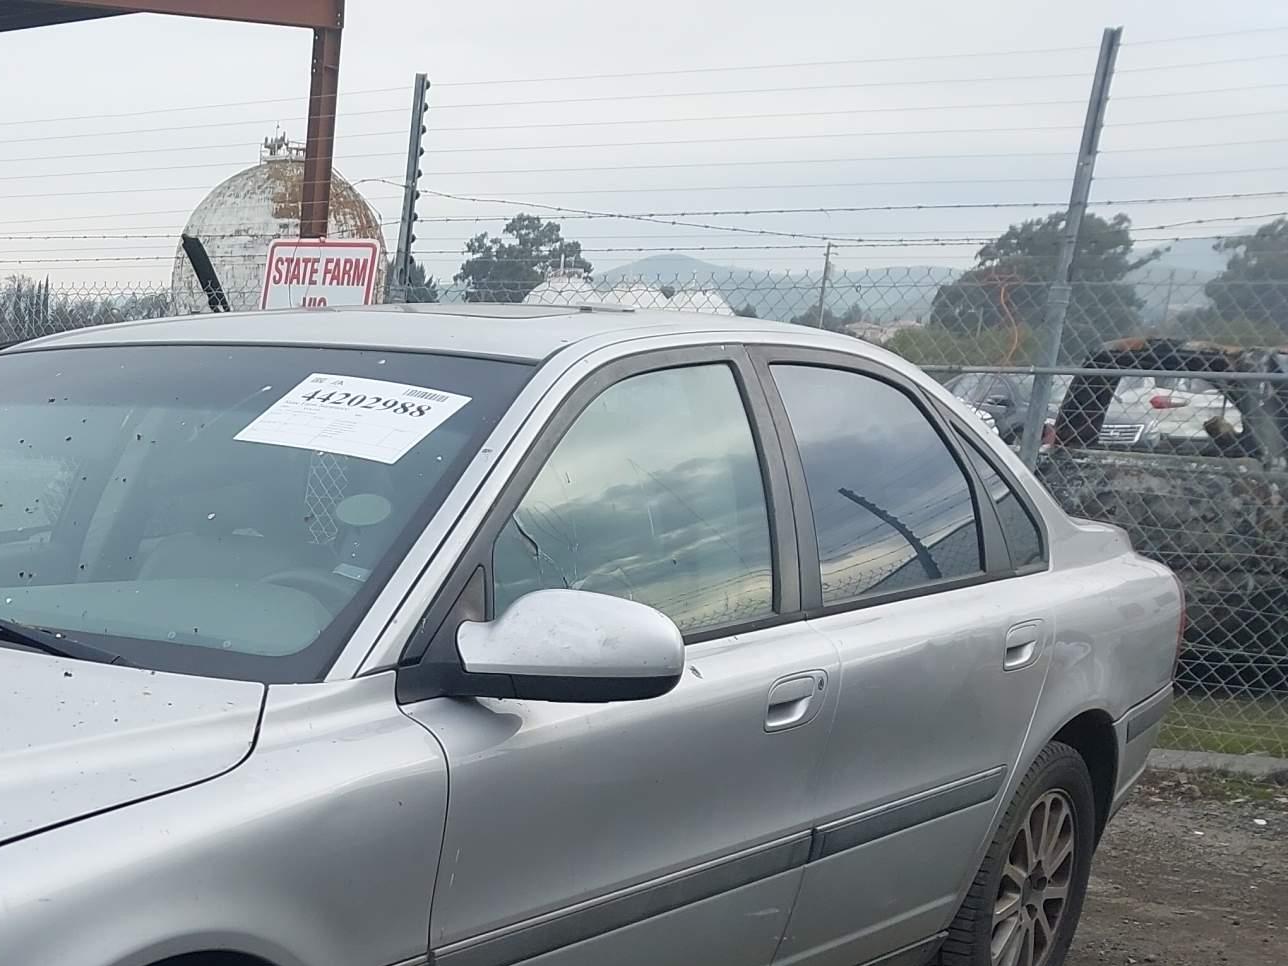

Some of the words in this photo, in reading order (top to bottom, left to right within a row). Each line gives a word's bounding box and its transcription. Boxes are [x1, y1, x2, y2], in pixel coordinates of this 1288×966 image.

[272, 256, 321, 286] STATE
[322, 257, 369, 287] FARM
[301, 389, 432, 418] 44202988
